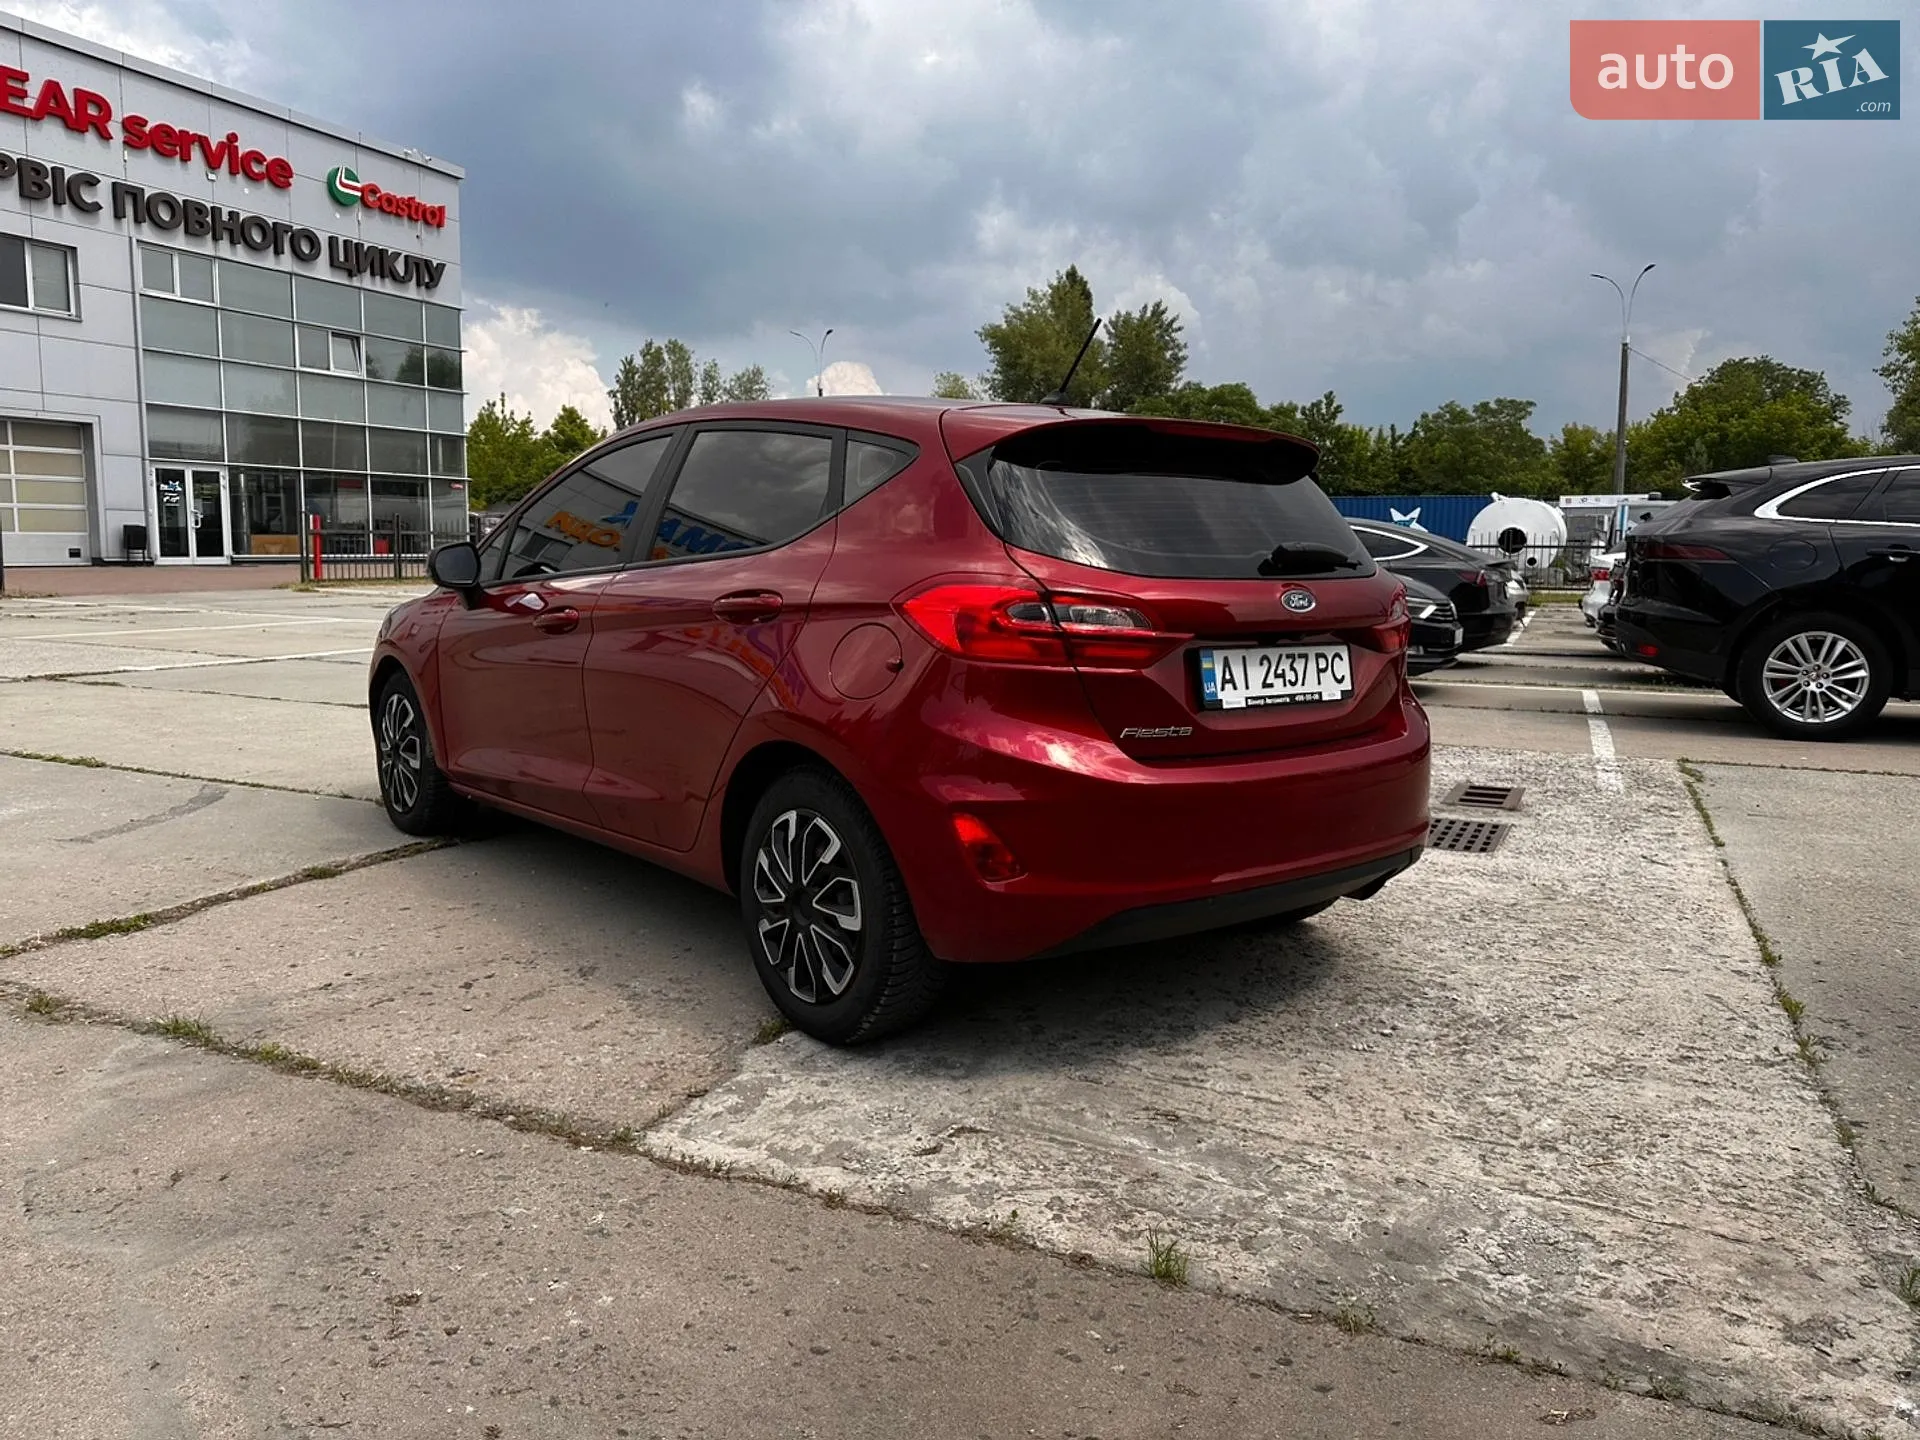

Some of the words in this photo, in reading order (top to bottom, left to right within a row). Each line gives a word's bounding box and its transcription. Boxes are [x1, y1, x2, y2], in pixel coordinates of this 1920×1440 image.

[0, 64, 113, 140] EAR
[122, 114, 294, 189] service
[361, 183, 447, 228] Castrol
[112, 181, 322, 262] ПОВНОГО
[328, 235, 446, 289] ЦИКЛУ
[1259, 653, 1309, 689] 2437
[1120, 726, 1193, 739] Fiesta
